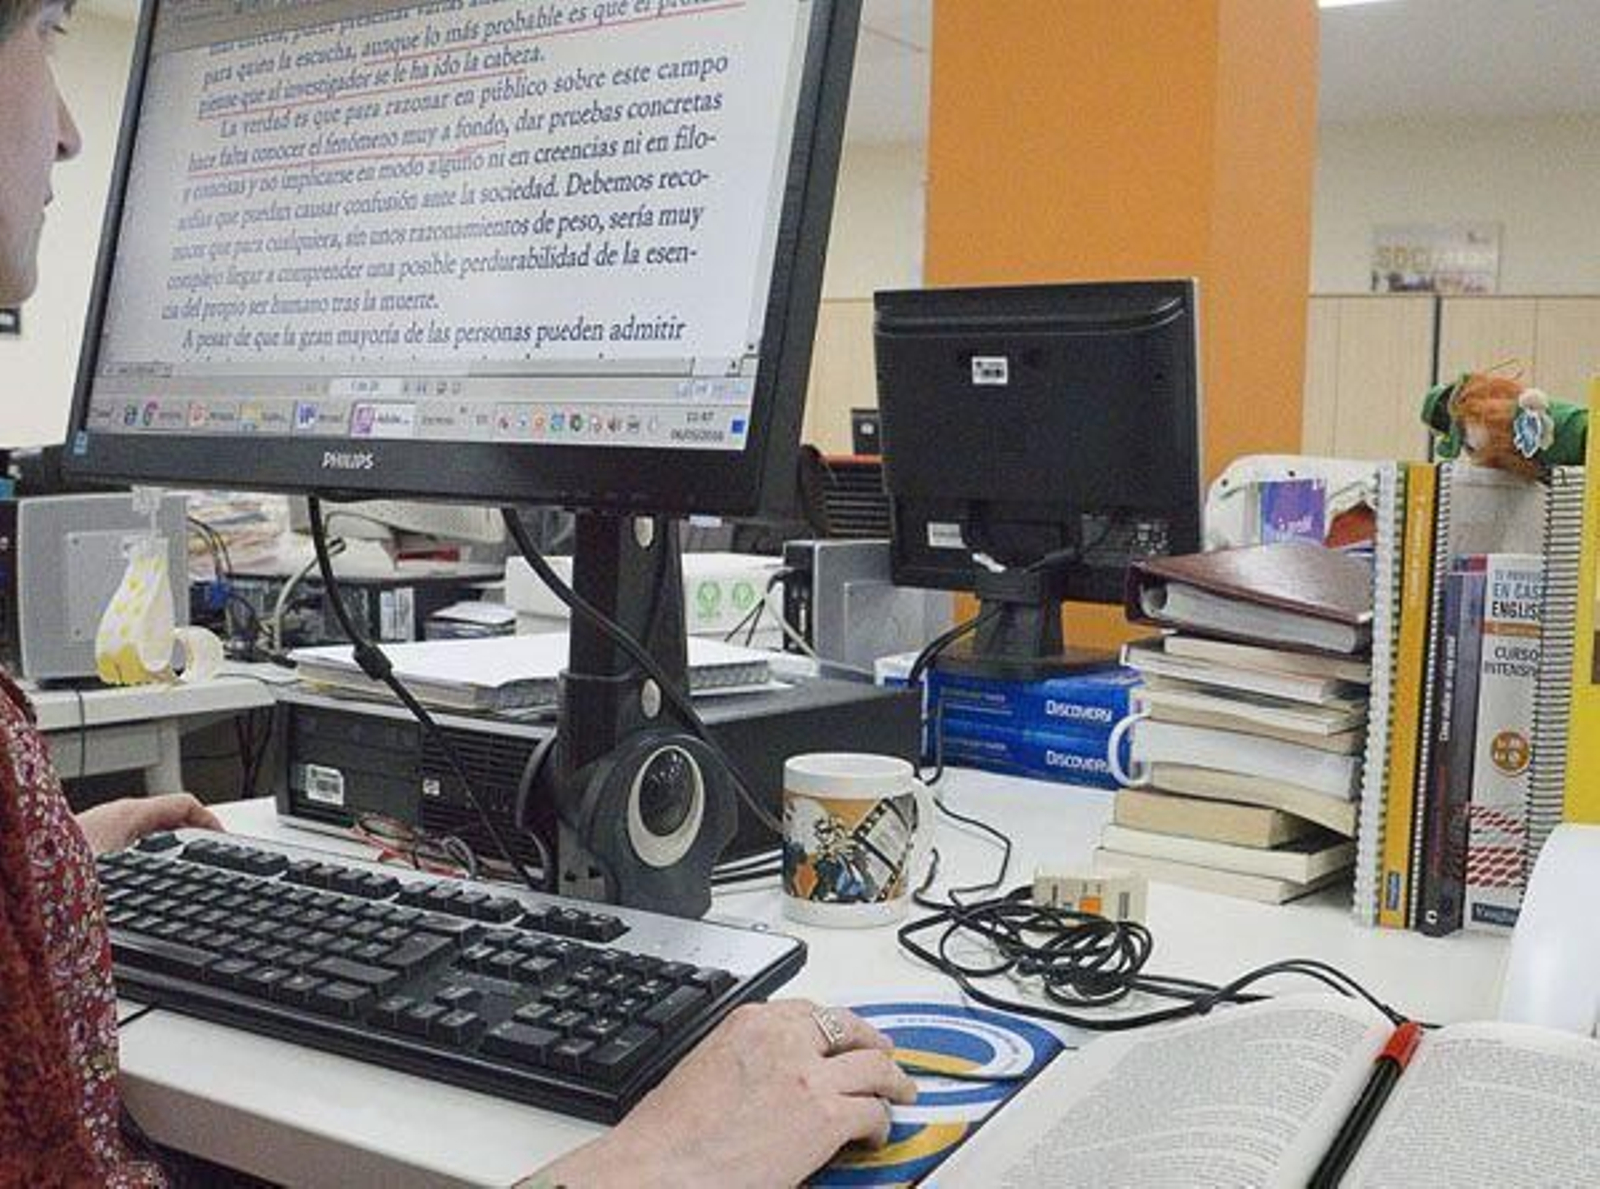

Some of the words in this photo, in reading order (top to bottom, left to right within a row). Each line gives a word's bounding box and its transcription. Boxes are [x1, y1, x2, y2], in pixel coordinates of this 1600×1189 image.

[204, 66, 231, 88] para
[237, 57, 274, 82] quien
[279, 51, 291, 69] la
[363, 33, 420, 61] aunque
[424, 28, 440, 48] lo
[446, 19, 477, 42] más
[484, 7, 562, 45] probable
[568, 6, 586, 24] es
[594, 1, 627, 25] que
[221, 118, 237, 138] La
[242, 108, 292, 131] verdad
[295, 113, 308, 126] es
[314, 106, 340, 132] que
[344, 103, 380, 127] para
[384, 92, 450, 117] razonar
[455, 89, 474, 106] en
[480, 72, 547, 108] público
[553, 69, 605, 93] sobre
[612, 63, 650, 86] este
[657, 55, 729, 83] campo
[240, 86, 266, 111] que
[269, 80, 282, 100] al
[374, 73, 390, 84] se
[394, 64, 406, 82] le
[411, 60, 429, 78] ha
[433, 52, 460, 76] ido
[464, 51, 482, 72] la
[219, 144, 249, 168] falta
[252, 144, 306, 164] conocer
[309, 137, 324, 156] el
[324, 129, 398, 156] fenómeno
[402, 130, 437, 151] muy
[454, 116, 509, 141] fondo,
[515, 111, 544, 132] dar
[549, 101, 623, 134] pruebas
[627, 92, 723, 119] concretas
[260, 179, 279, 193] no
[282, 166, 353, 194] implicarse
[356, 168, 376, 182] en
[380, 155, 424, 179] modo
[488, 151, 506, 168] ni
[509, 149, 528, 166] en
[534, 137, 618, 165] creencias
[624, 134, 642, 156] ni
[646, 134, 668, 152] en
[675, 125, 717, 151] filo-
[215, 212, 238, 230] que
[241, 204, 291, 228] puedan
[294, 201, 341, 219] causar
[343, 192, 417, 216] confusión
[421, 193, 457, 208] ante
[460, 183, 477, 204] la
[480, 175, 560, 202] sociedad.
[564, 170, 654, 196] Debemos
[658, 170, 710, 189] reco-
[211, 244, 232, 262] que
[233, 240, 263, 258] para
[345, 228, 367, 246] sin
[369, 230, 405, 245] unos
[409, 213, 529, 243] razonamientos
[533, 209, 552, 234] de
[558, 211, 605, 239] peso,
[609, 204, 653, 229] sería
[658, 205, 705, 231] muy
[277, 261, 363, 288] comprender
[366, 266, 395, 279] una
[399, 252, 459, 283] posible
[460, 242, 590, 280] perdurabilidad
[594, 245, 617, 267] de
[622, 240, 640, 265] la
[646, 244, 697, 265] esen-
[180, 297, 200, 317] del
[249, 302, 267, 315] ser
[270, 294, 330, 315] humano
[332, 296, 360, 313] tras
[362, 289, 377, 311] la
[380, 292, 440, 311] muerte.
[195, 331, 231, 352] pesar
[236, 326, 250, 346] de
[254, 330, 280, 352] que
[283, 324, 297, 346] la
[300, 329, 333, 352] gran
[337, 323, 400, 350] mayoría
[404, 321, 424, 344] de
[427, 321, 450, 344] las
[454, 322, 531, 350] personas
[535, 314, 605, 348] pueden
[608, 313, 687, 342] admitir
[321, 450, 374, 470] PHILIPS
[1491, 600, 1541, 621] ENGLIS
[1495, 645, 1539, 662] CURSO
